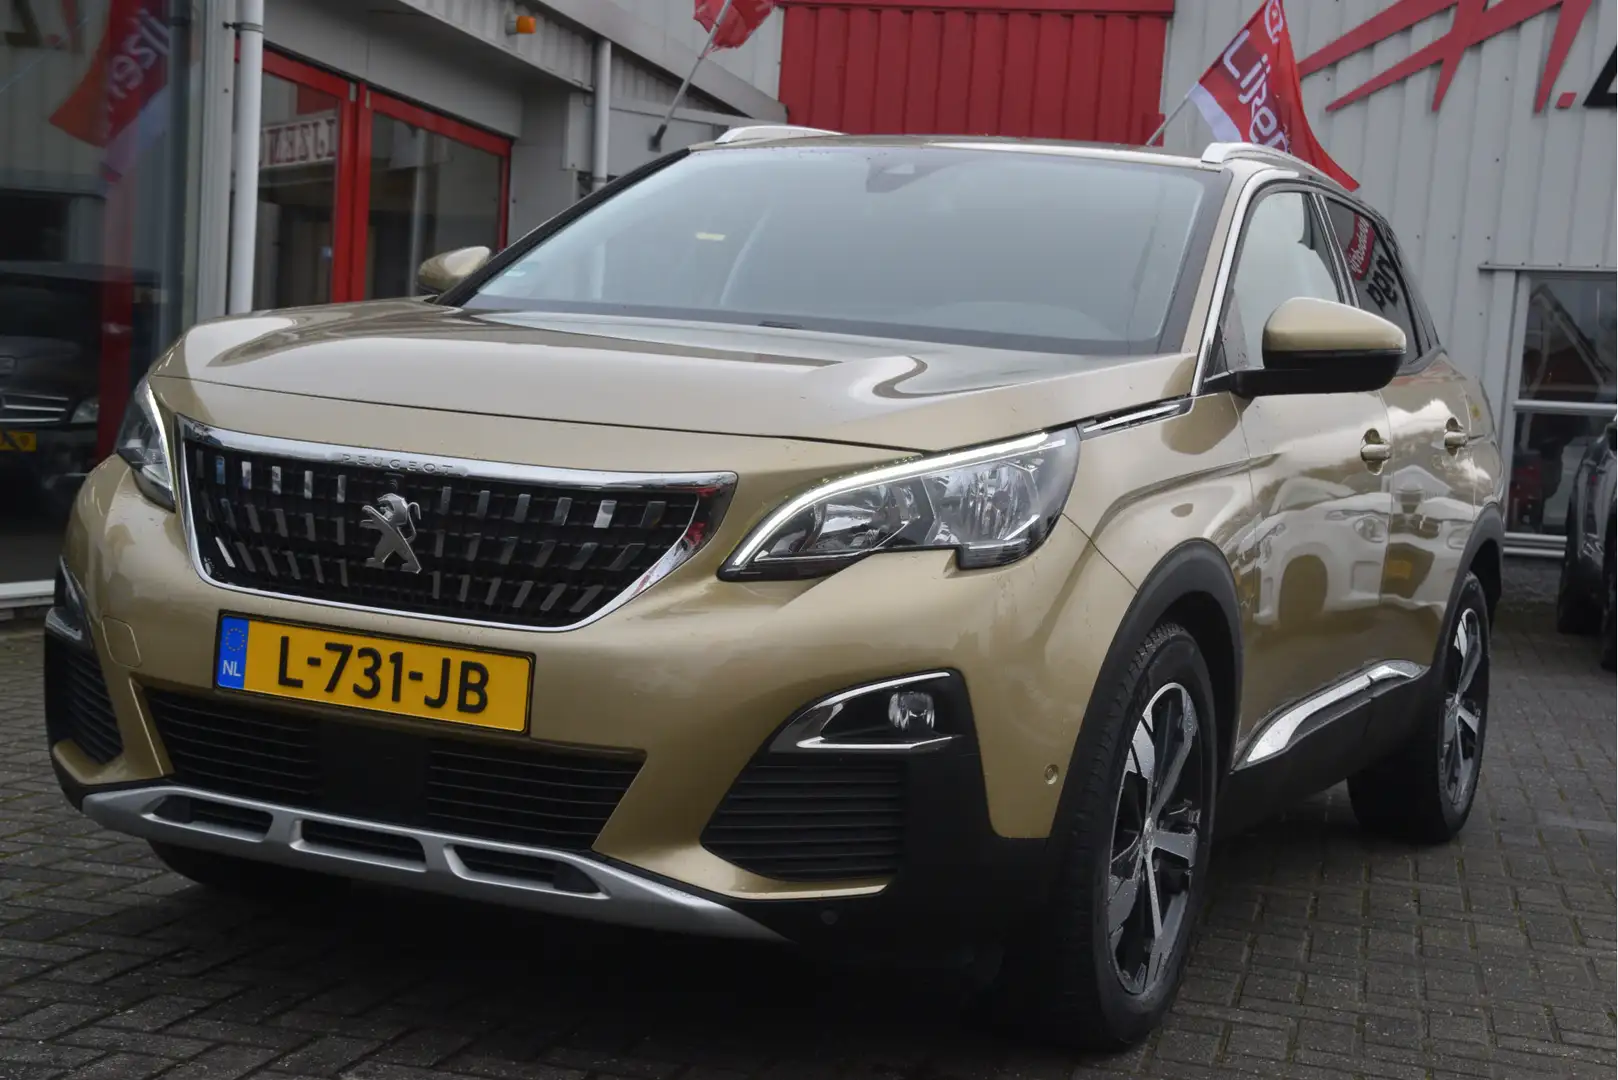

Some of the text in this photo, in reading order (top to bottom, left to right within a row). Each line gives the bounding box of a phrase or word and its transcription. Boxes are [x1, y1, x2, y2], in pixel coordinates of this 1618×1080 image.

[342, 453, 453, 475] PEUGEOT
[222, 660, 241, 678] NL
[277, 635, 489, 714] L-731-JB
